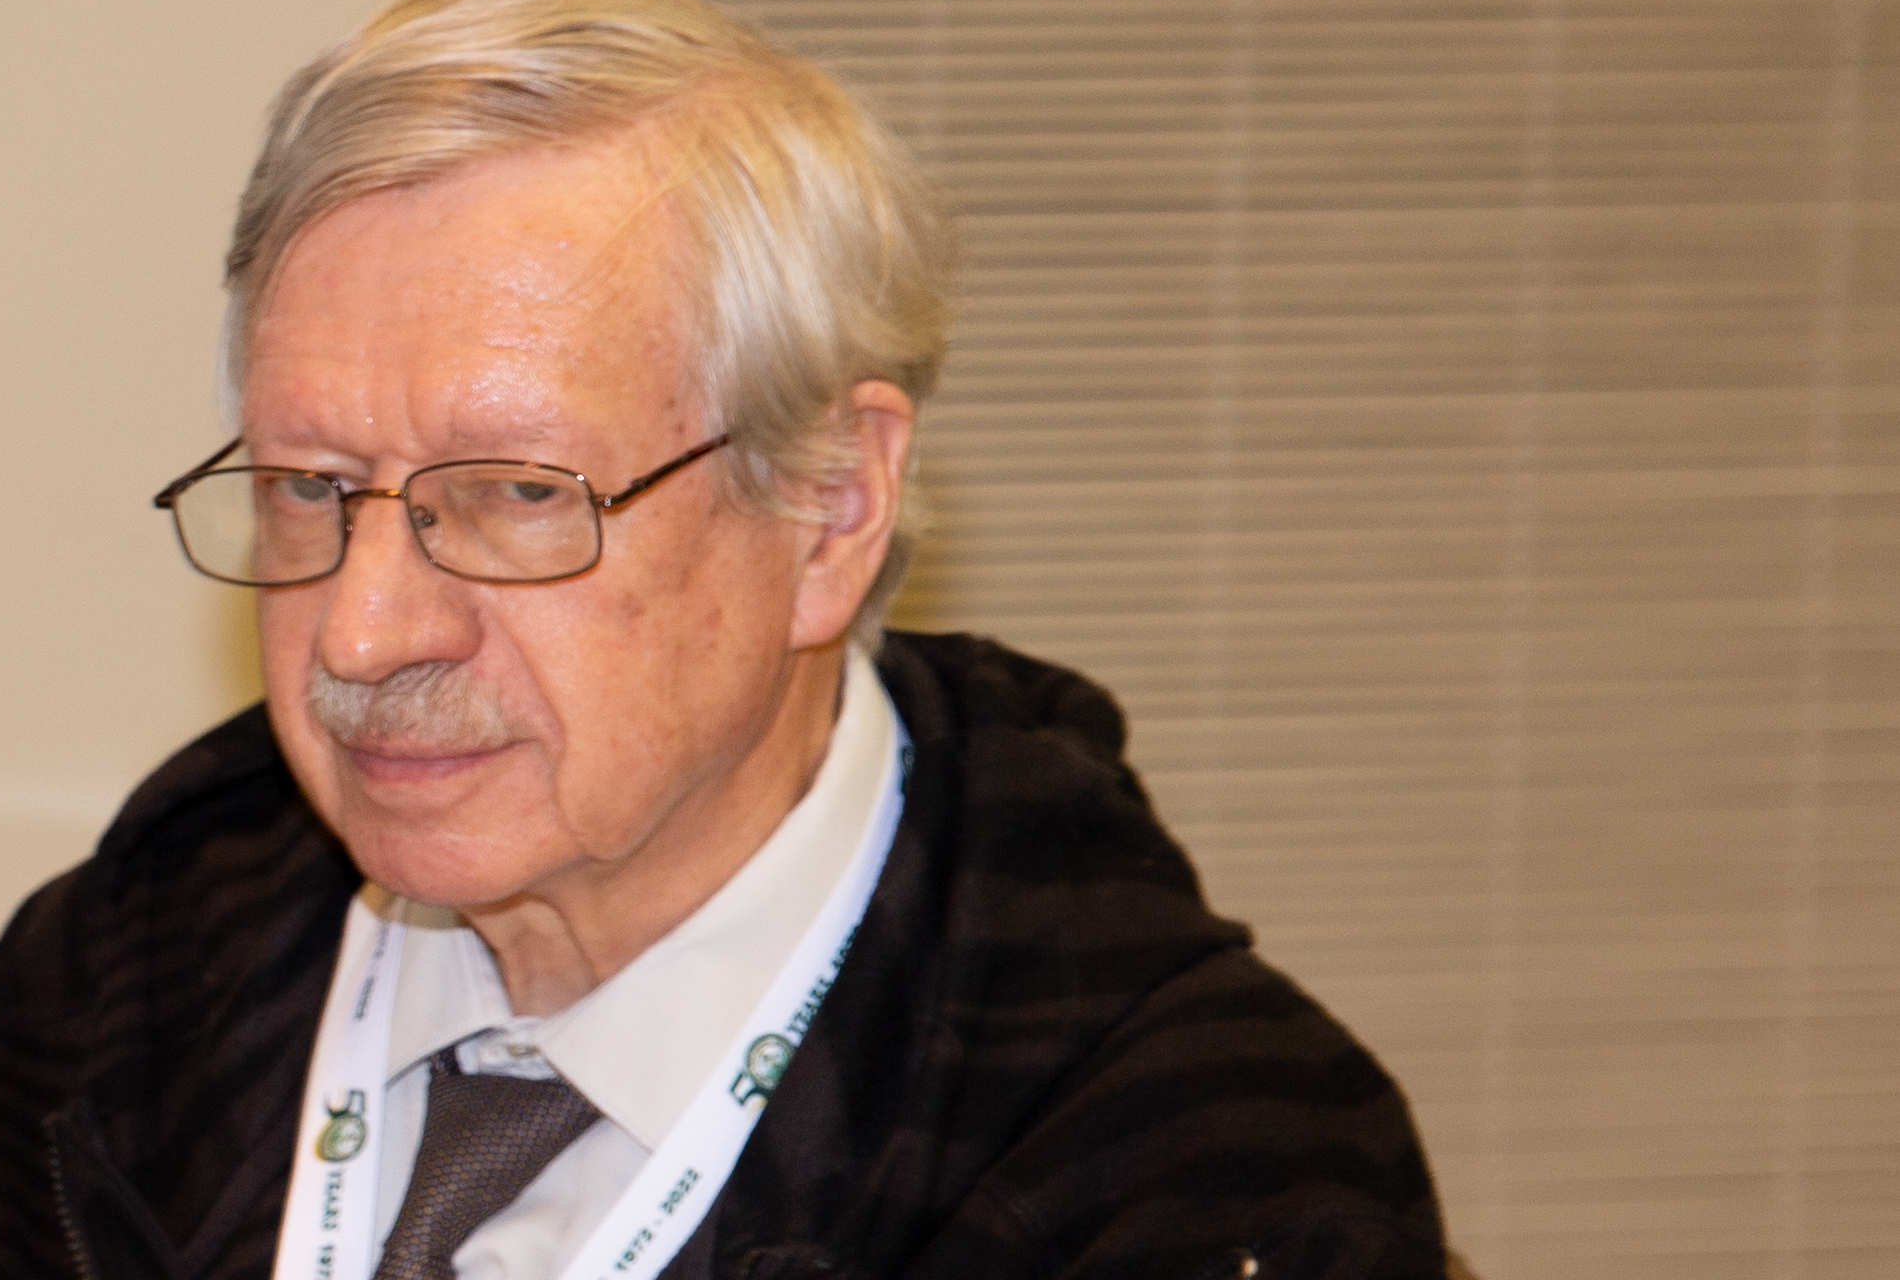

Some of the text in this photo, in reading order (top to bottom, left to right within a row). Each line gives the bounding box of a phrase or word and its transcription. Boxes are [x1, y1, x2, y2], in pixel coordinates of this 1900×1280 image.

[321, 1167, 347, 1232] YEARS
[613, 1225, 655, 1273] 1972
[658, 1166, 701, 1215] 2022
